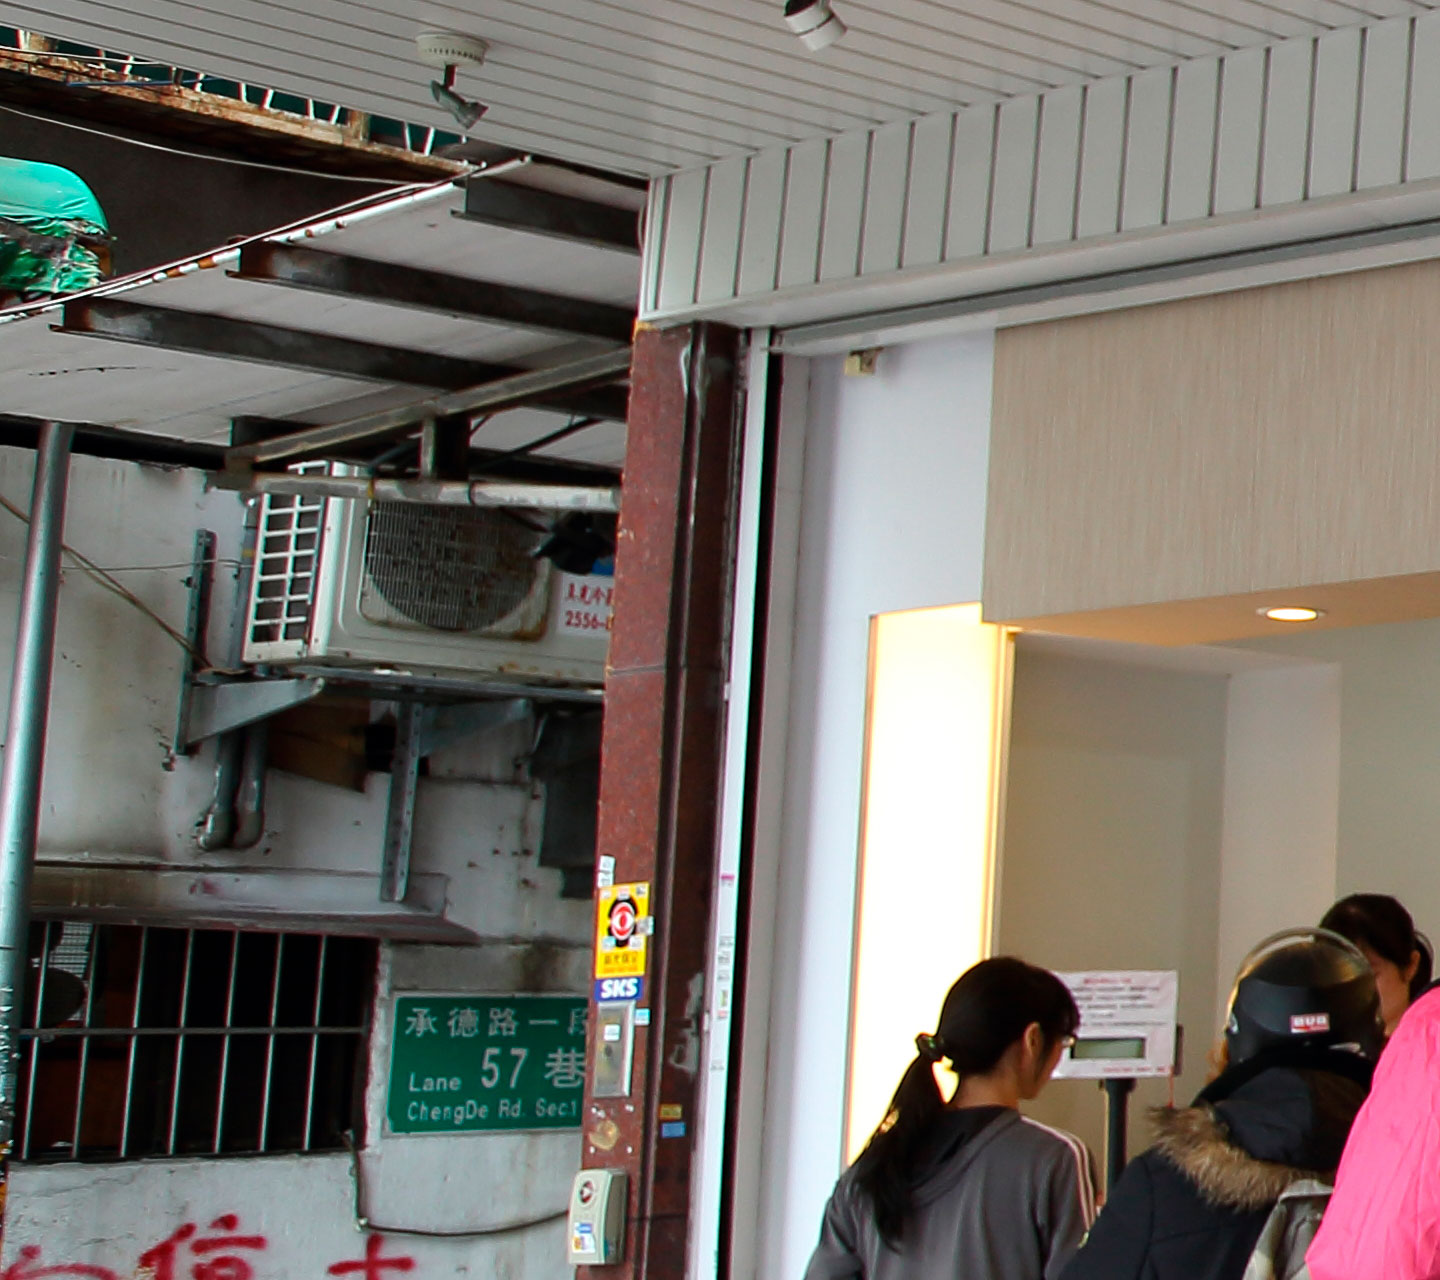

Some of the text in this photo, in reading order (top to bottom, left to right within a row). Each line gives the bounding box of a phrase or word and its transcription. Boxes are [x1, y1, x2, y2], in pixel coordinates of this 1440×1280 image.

[566, 610, 614, 629] 2556-
[601, 977, 638, 999] SKS
[408, 1047, 587, 1092] Lane 57 巷
[407, 1099, 490, 1125] ChengDe
